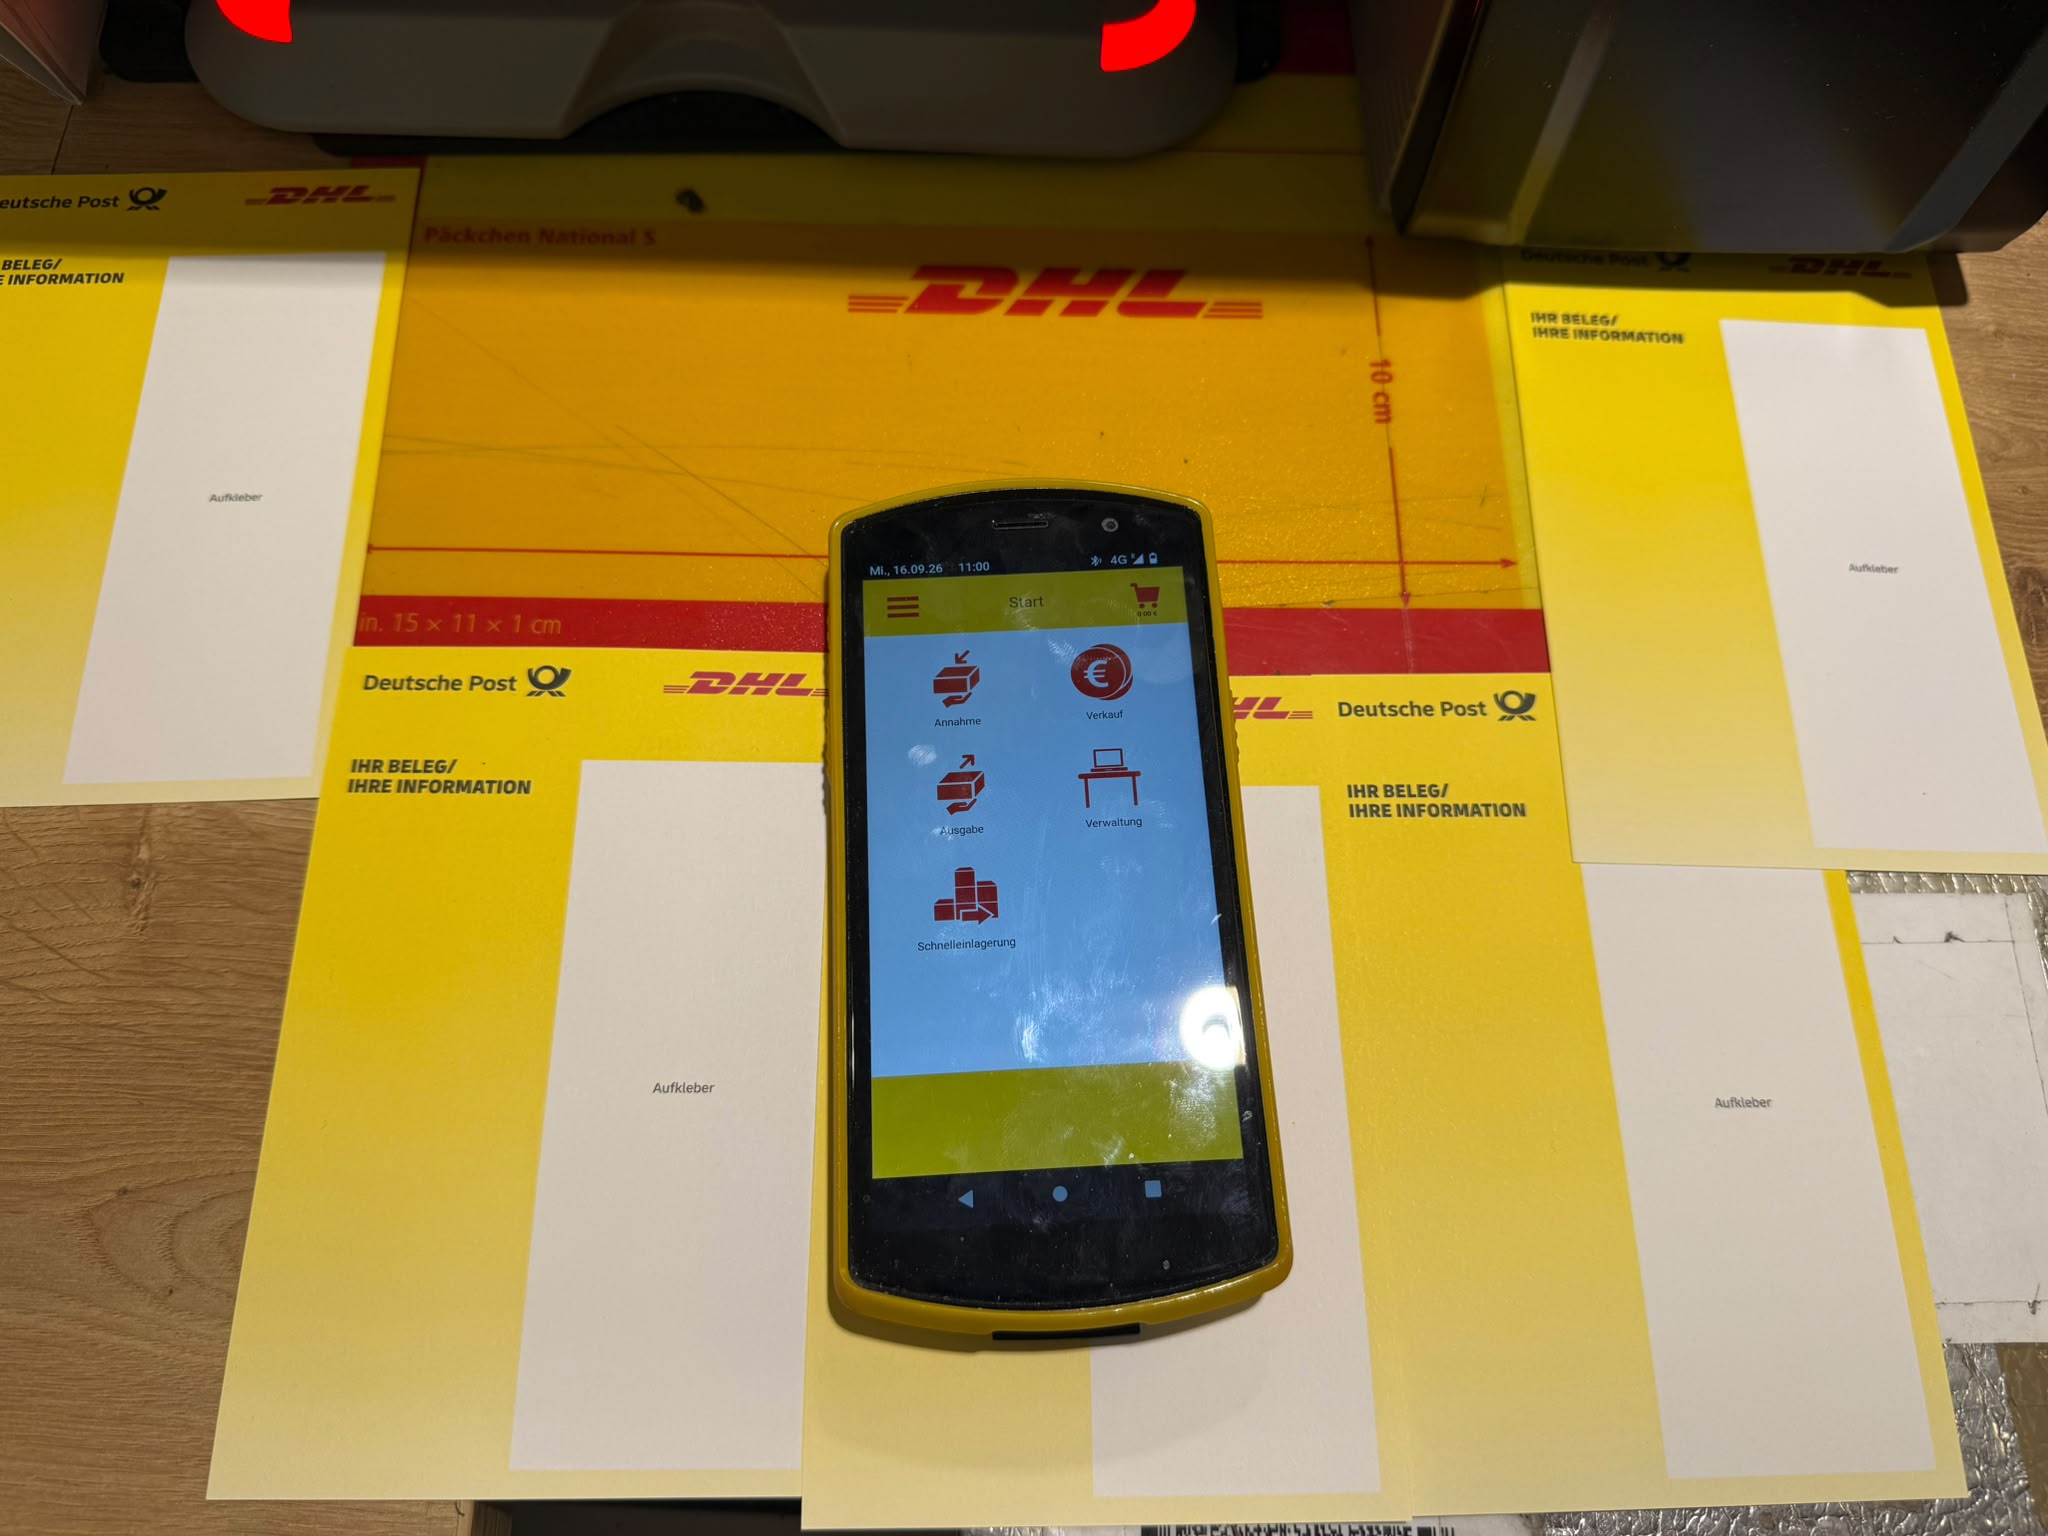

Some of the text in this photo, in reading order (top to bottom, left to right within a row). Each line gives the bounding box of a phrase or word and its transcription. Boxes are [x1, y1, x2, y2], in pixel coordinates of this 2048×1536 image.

[0, 194, 120, 209] eutsche Post
[266, 185, 374, 206] DHL
[424, 226, 657, 246] Päckchen National S
[1, 258, 62, 272] BELEG/
[1788, 256, 1892, 278] DHL
[7, 272, 125, 286] INFORMATION
[903, 264, 1207, 318] DHL
[1530, 311, 1619, 328] IHR BELEG/
[1532, 327, 1684, 345] IHRE INFORMATION
[1369, 359, 1393, 424] 10 cm
[208, 492, 263, 503] Aufkleber
[1110, 554, 1128, 565] 4G
[869, 561, 990, 577] Mi., 16.09.26 11:00
[1848, 563, 1899, 574] Aufkleber
[1009, 595, 1044, 610] Start
[359, 612, 384, 632] in.
[394, 613, 419, 632] 15
[453, 614, 477, 633] 11
[512, 614, 522, 633] 1
[530, 618, 562, 634] cm
[363, 674, 517, 692] Deutsche Post
[687, 671, 816, 697] DHL
[1086, 709, 1124, 720] Verkauf
[1232, 696, 1290, 720] HL
[1338, 701, 1488, 718] Deutsche Post
[934, 716, 982, 728] Annahme
[350, 759, 458, 774] IHR BELEG/
[347, 778, 532, 795] IHRE INFORMATION
[1347, 783, 1449, 799] IHR BELEG/
[1349, 802, 1526, 818] IHRE INFORMATION
[939, 824, 984, 837] Ausgabe
[1085, 816, 1143, 829] Verwaltung
[917, 936, 1016, 952] Schnelleinlagerung
[652, 1081, 715, 1094] Aufkleber
[1714, 1096, 1773, 1108] Aufkleber
